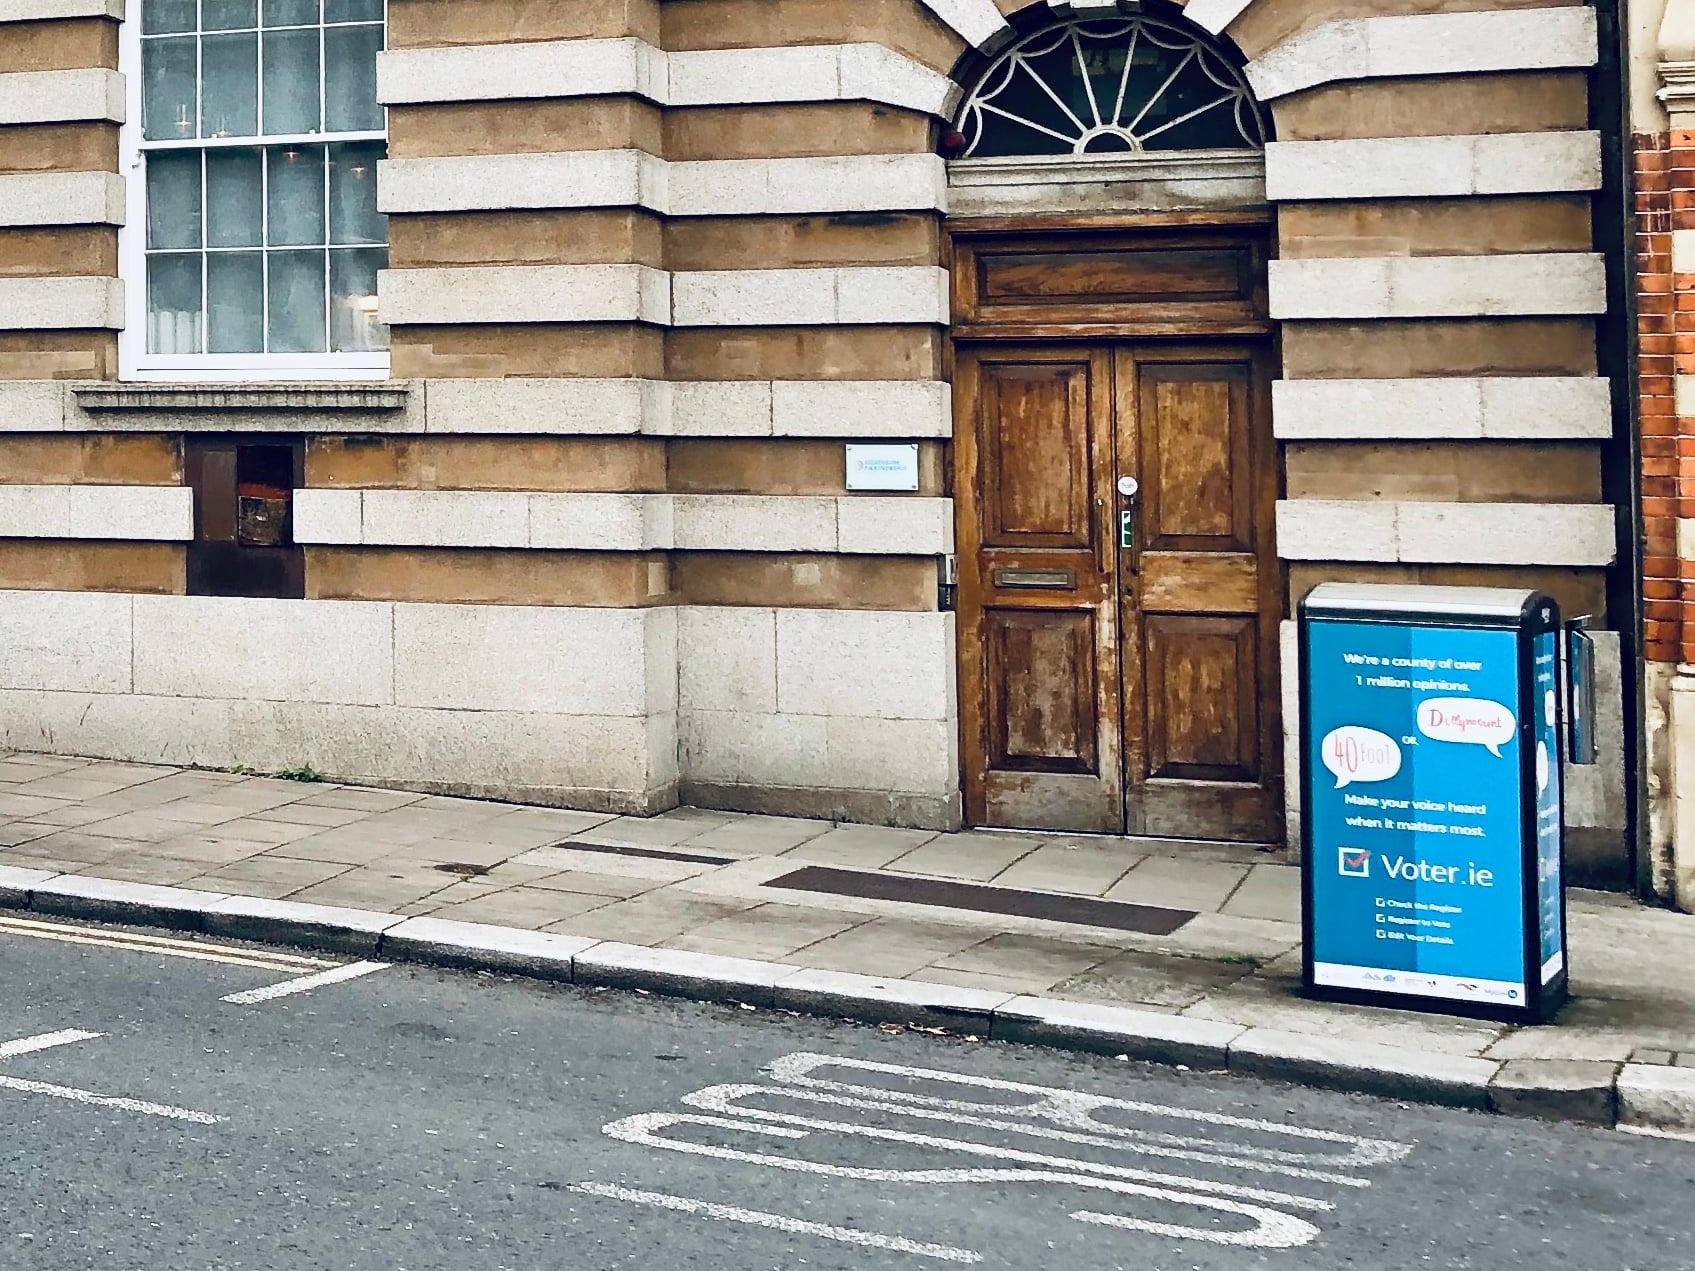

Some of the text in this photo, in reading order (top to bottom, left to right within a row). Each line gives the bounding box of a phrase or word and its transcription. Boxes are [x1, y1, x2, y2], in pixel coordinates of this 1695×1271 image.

[1343, 653, 1482, 670] We're a county of over
[1356, 675, 1471, 691] 1 million opinions.
[1334, 734, 1359, 773] 40
[1344, 793, 1487, 815] Make your voice heard
[1345, 816, 1487, 837] when it matters most.
[1380, 854, 1494, 887] Voter.ie
